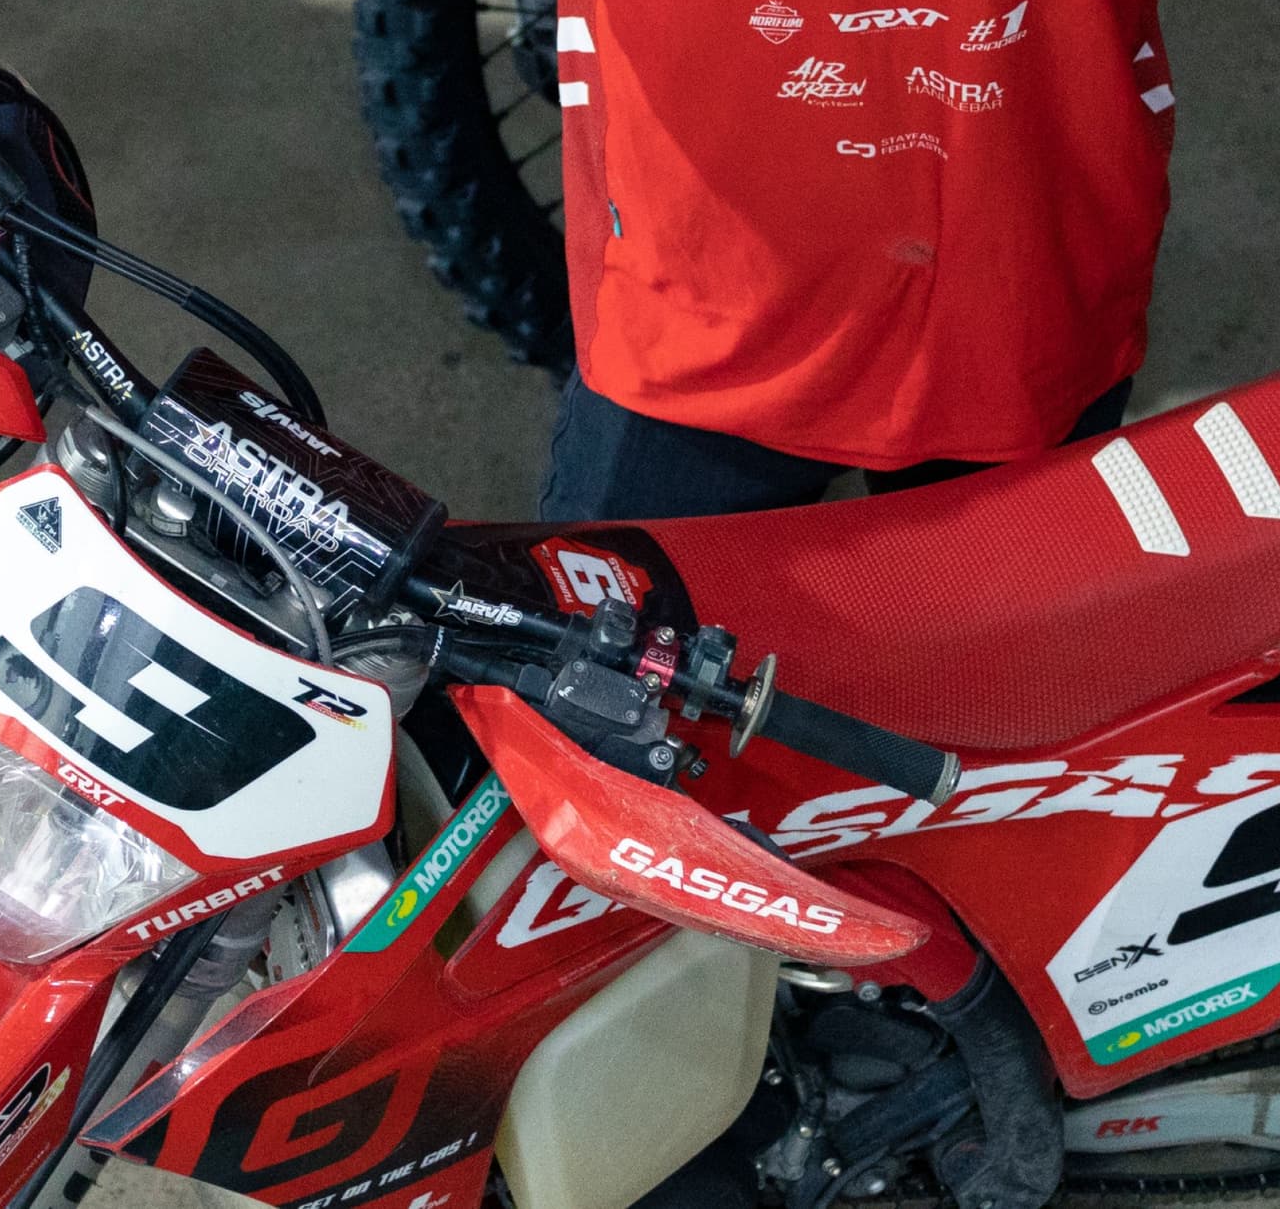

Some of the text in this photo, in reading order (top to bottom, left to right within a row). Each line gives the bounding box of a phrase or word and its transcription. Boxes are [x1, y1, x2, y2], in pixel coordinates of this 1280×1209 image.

[748, 15, 804, 29] NORIFUMI
[776, 77, 867, 101] SCREEN
[787, 56, 846, 84] AIR
[905, 66, 1004, 103] ASTRA
[907, 85, 1003, 113] HANDLEBAR
[72, 330, 135, 401] ASTRA
[239, 390, 343, 458] JARVIS
[195, 420, 354, 542] ASTRA
[608, 556, 637, 606] GASGAS
[447, 598, 524, 627] JARVIS
[414, 779, 508, 894] MOTOREX
[127, 865, 286, 943] TURBAT
[609, 837, 844, 935] GASGAS
[1108, 978, 1169, 1007] brembo
[1143, 982, 1259, 1038] MOTOREX
[1096, 1114, 1162, 1140] RK
[297, 1193, 337, 1209] GET
[340, 1181, 373, 1202] ON
[378, 1161, 417, 1187] THE
[420, 1139, 463, 1169] GAS
